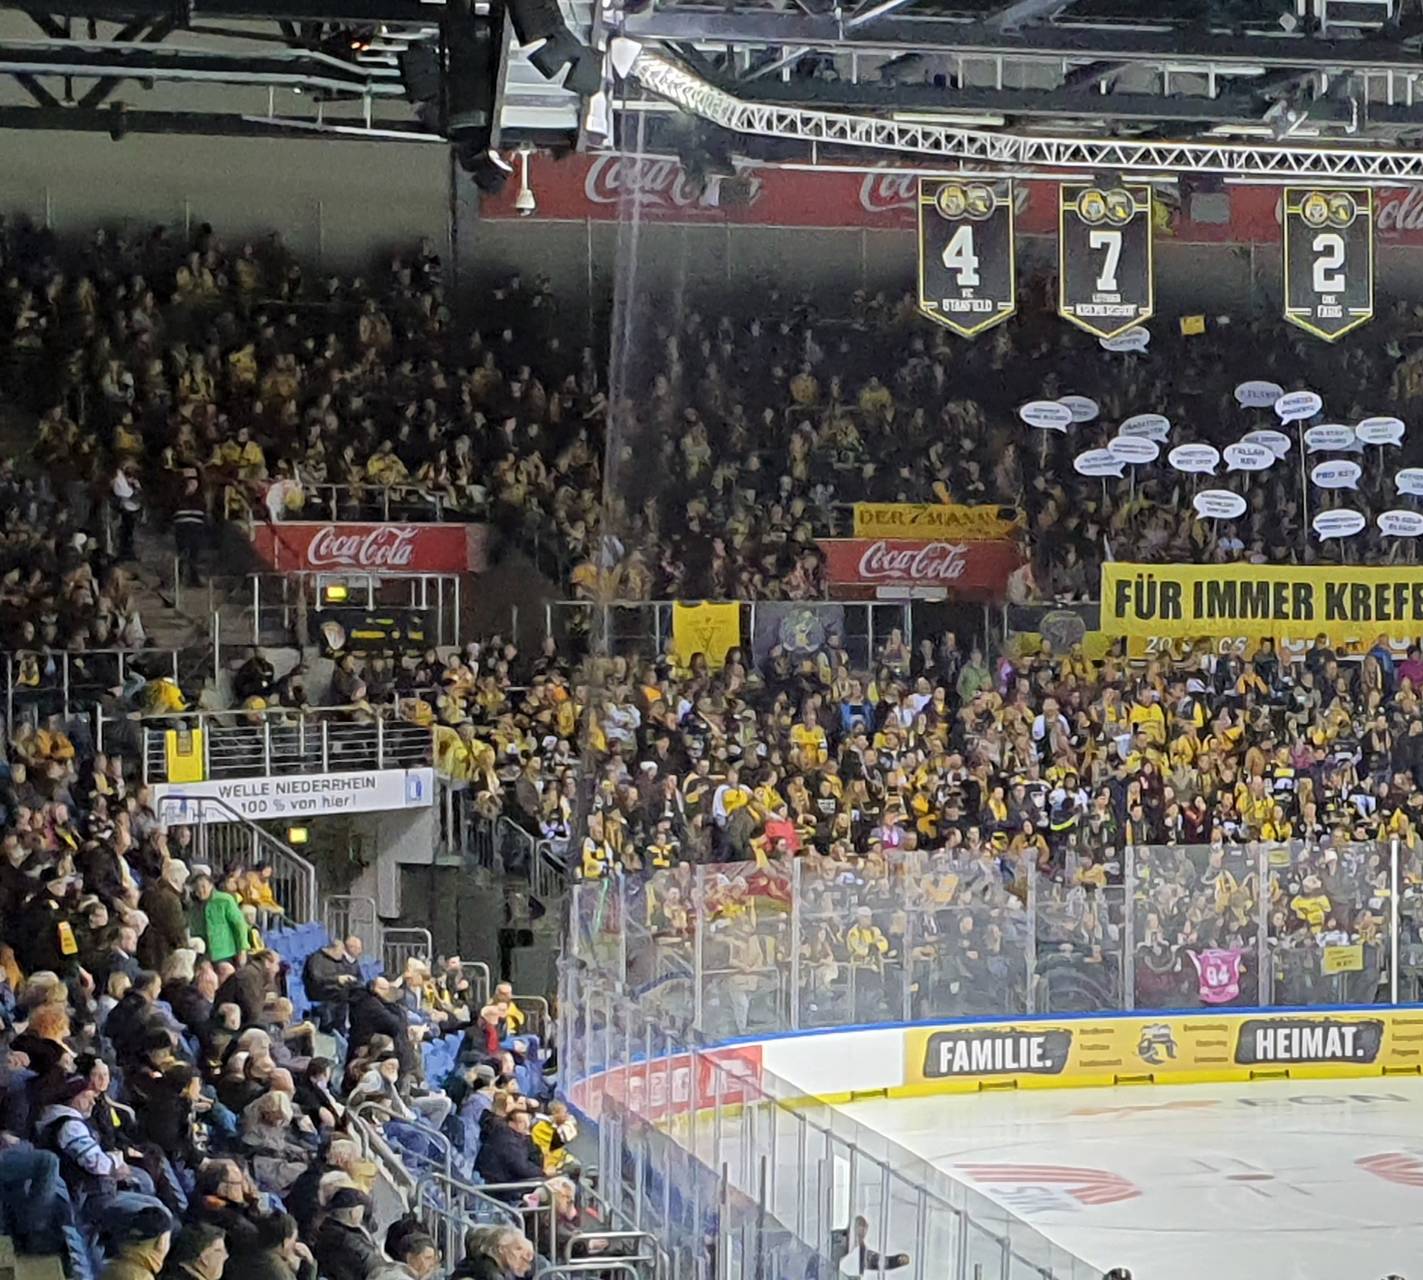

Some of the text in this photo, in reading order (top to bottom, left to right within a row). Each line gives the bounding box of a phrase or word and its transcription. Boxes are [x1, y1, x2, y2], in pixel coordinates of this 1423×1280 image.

[942, 225, 980, 286] 4
[1089, 230, 1122, 291] 7
[1312, 233, 1345, 292] 2
[860, 510, 901, 525] DER
[1115, 573, 1182, 620] FÜR
[1193, 581, 1314, 620] IMMER
[218, 776, 376, 799] WELLE NIEDERRHEIN
[241, 800, 268, 814] 100
[291, 799, 317, 810] von
[940, 1036, 1052, 1074] FAMILIE.
[1256, 1026, 1364, 1060] HEIMAT.
